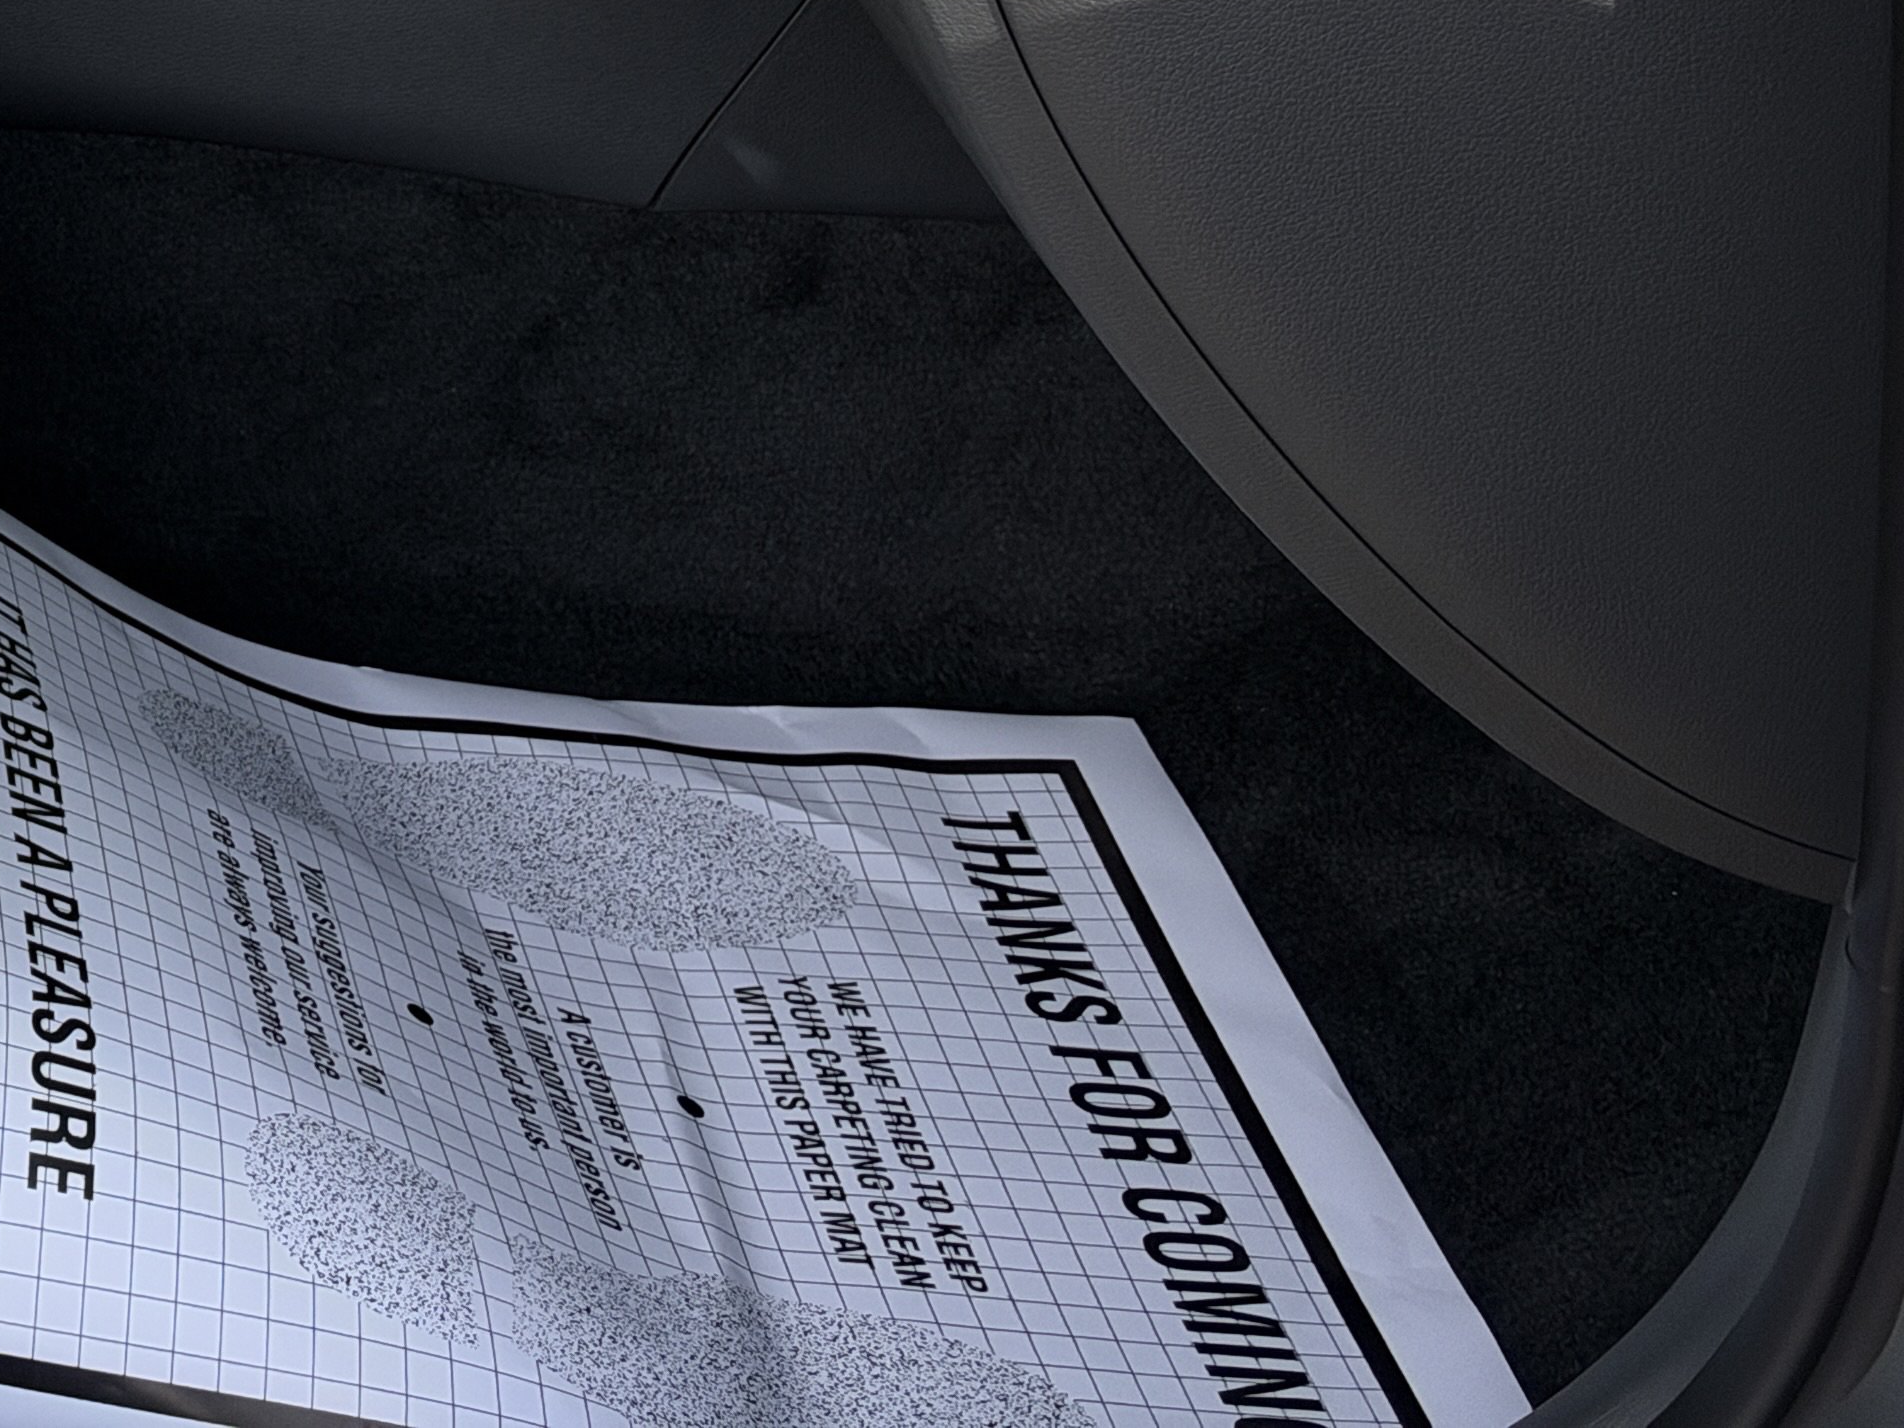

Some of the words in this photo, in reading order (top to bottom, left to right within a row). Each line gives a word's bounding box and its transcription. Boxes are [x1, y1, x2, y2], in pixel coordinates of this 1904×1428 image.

[0, 711, 68, 835] BEEN
[14, 833, 74, 874] A
[207, 808, 236, 855] are
[217, 850, 257, 933] always
[250, 827, 300, 949] improving
[296, 860, 330, 913] Your
[280, 946, 312, 997] our
[457, 950, 486, 977] in
[484, 928, 519, 964] the
[238, 934, 287, 1047] welcome.
[311, 912, 373, 1057] suggestions
[468, 981, 498, 1017] the
[499, 967, 546, 1025] most
[557, 1007, 592, 1025] A
[827, 981, 871, 1018] WE
[20, 882, 97, 1201] PLEASURE
[293, 991, 341, 1080] service
[482, 1021, 531, 1088] world
[844, 1025, 901, 1090] HAVE
[353, 1057, 388, 1097] for
[507, 1087, 537, 1121] to
[525, 1031, 591, 1146] important
[566, 1031, 630, 1143] customer
[519, 1119, 551, 1151] us.
[733, 985, 786, 1048] WITH
[760, 1053, 811, 1111] THIS
[788, 1119, 847, 1202] PAPER
[820, 1212, 875, 1273] MAT
[778, 976, 831, 1041] YOUR
[806, 1048, 894, 1191] CARPETING
[868, 1200, 936, 1289] CLEAN
[875, 1096, 935, 1176] TRIED
[941, 811, 1123, 1025] THANKS
[1048, 1044, 1193, 1165] FOR
[1121, 1188, 1328, 1428] COMIN
[569, 1145, 623, 1232] person
[610, 1146, 644, 1171] is
[910, 1180, 955, 1216] TO
[927, 1222, 988, 1293] KEEP
